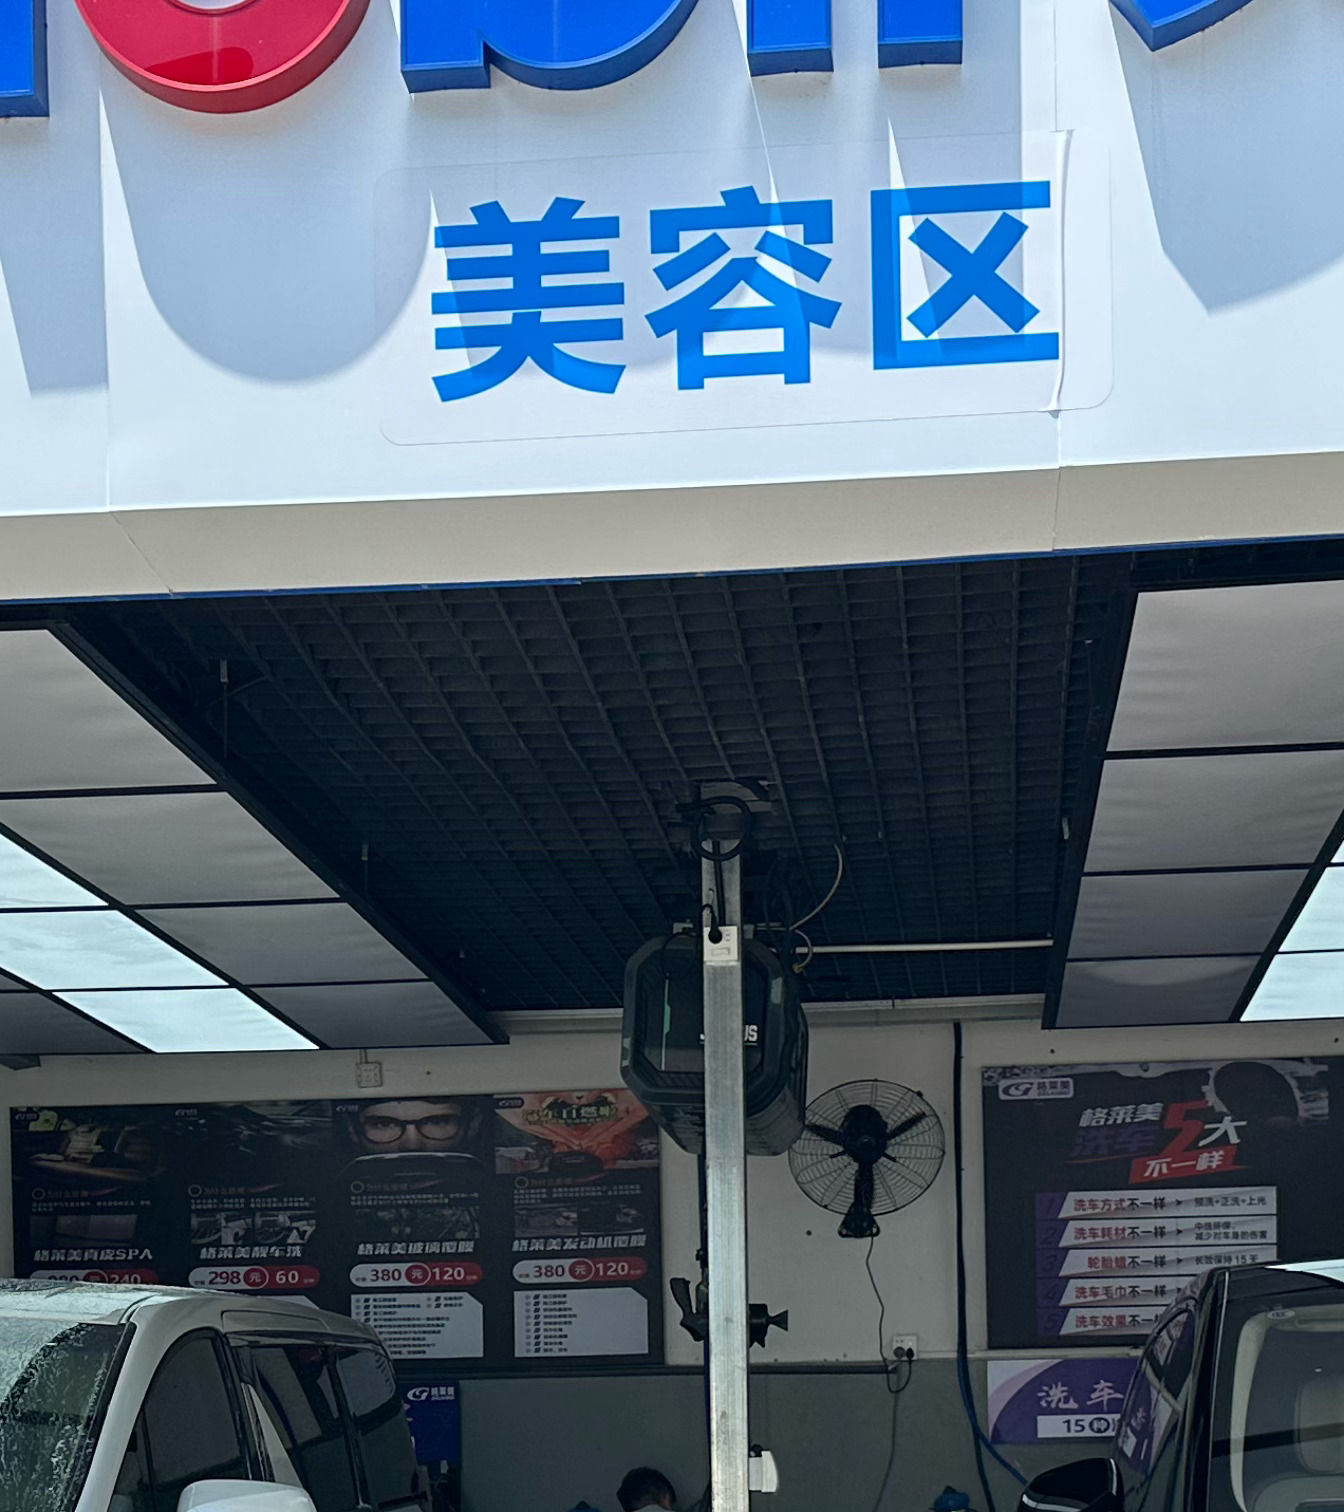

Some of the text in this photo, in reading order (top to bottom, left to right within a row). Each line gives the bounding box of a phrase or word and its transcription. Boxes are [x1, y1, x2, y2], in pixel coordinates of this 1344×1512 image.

[431, 180, 1059, 401] 美容区
[1079, 1102, 1164, 1127] 格莱美
[1070, 1122, 1155, 1157] 洗车
[1143, 1150, 1224, 1177] 不一样
[1073, 1196, 1165, 1212] 洗车方式不一样
[1073, 1225, 1166, 1240] 洗车耗材不一样
[596, 1262, 629, 1276] 120
[1087, 1254, 1167, 1269] 轮胎蜡不一样
[208, 1271, 262, 1285] 298 元
[276, 1270, 299, 1285] 60
[370, 1268, 423, 1282] 380 元
[432, 1267, 465, 1281] 120
[533, 1264, 587, 1278] 380 元
[1075, 1284, 1167, 1299] 洗车毛巾不一样
[1075, 1313, 1157, 1329] 洗车效果不一
[1037, 1380, 1124, 1412] 洗车
[1063, 1419, 1085, 1433] 15
